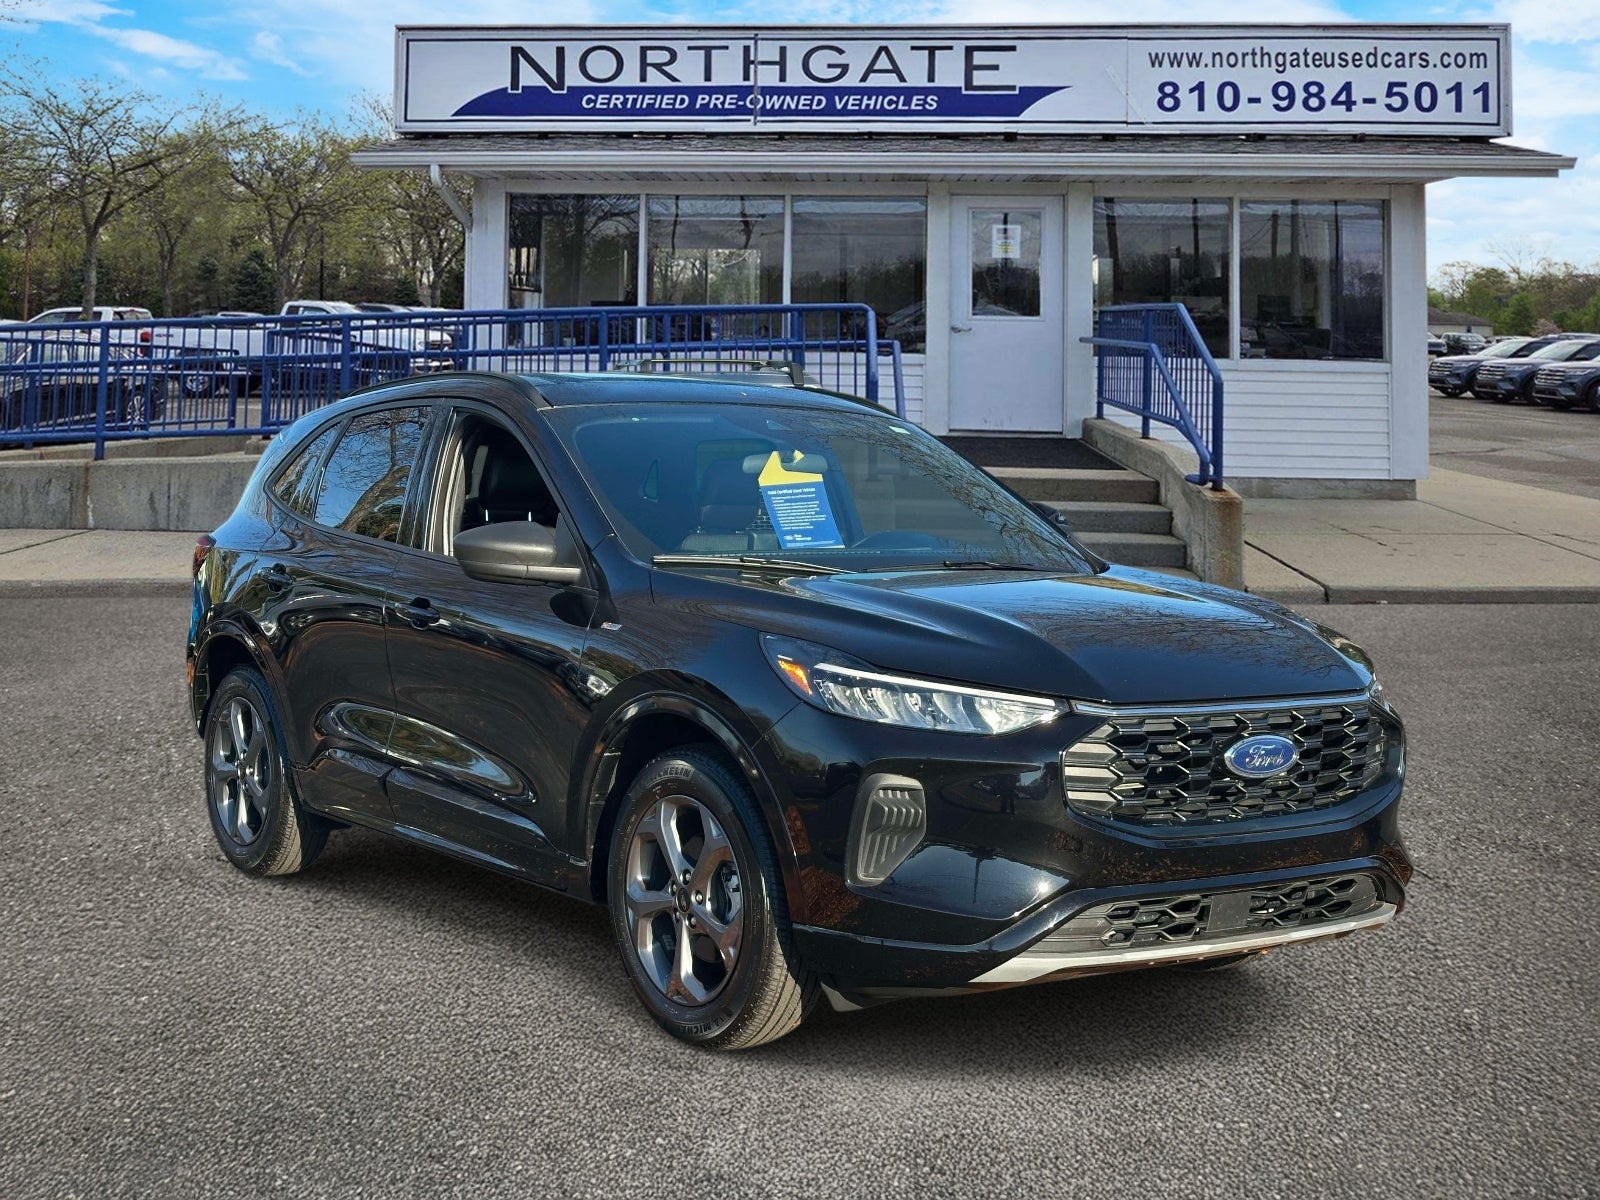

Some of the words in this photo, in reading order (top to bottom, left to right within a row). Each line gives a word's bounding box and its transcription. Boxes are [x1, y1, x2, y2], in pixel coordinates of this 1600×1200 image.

[510, 45, 1017, 92] NORTHGATE
[1149, 47, 1488, 74] www.northgateusedcars.com
[581, 94, 689, 110] CERTIFIED
[695, 94, 827, 110] PRE-OWNED
[834, 94, 938, 111] VEHICLES
[1157, 81, 1491, 114] 810-984-5011
[1245, 744, 1284, 768] Ford
